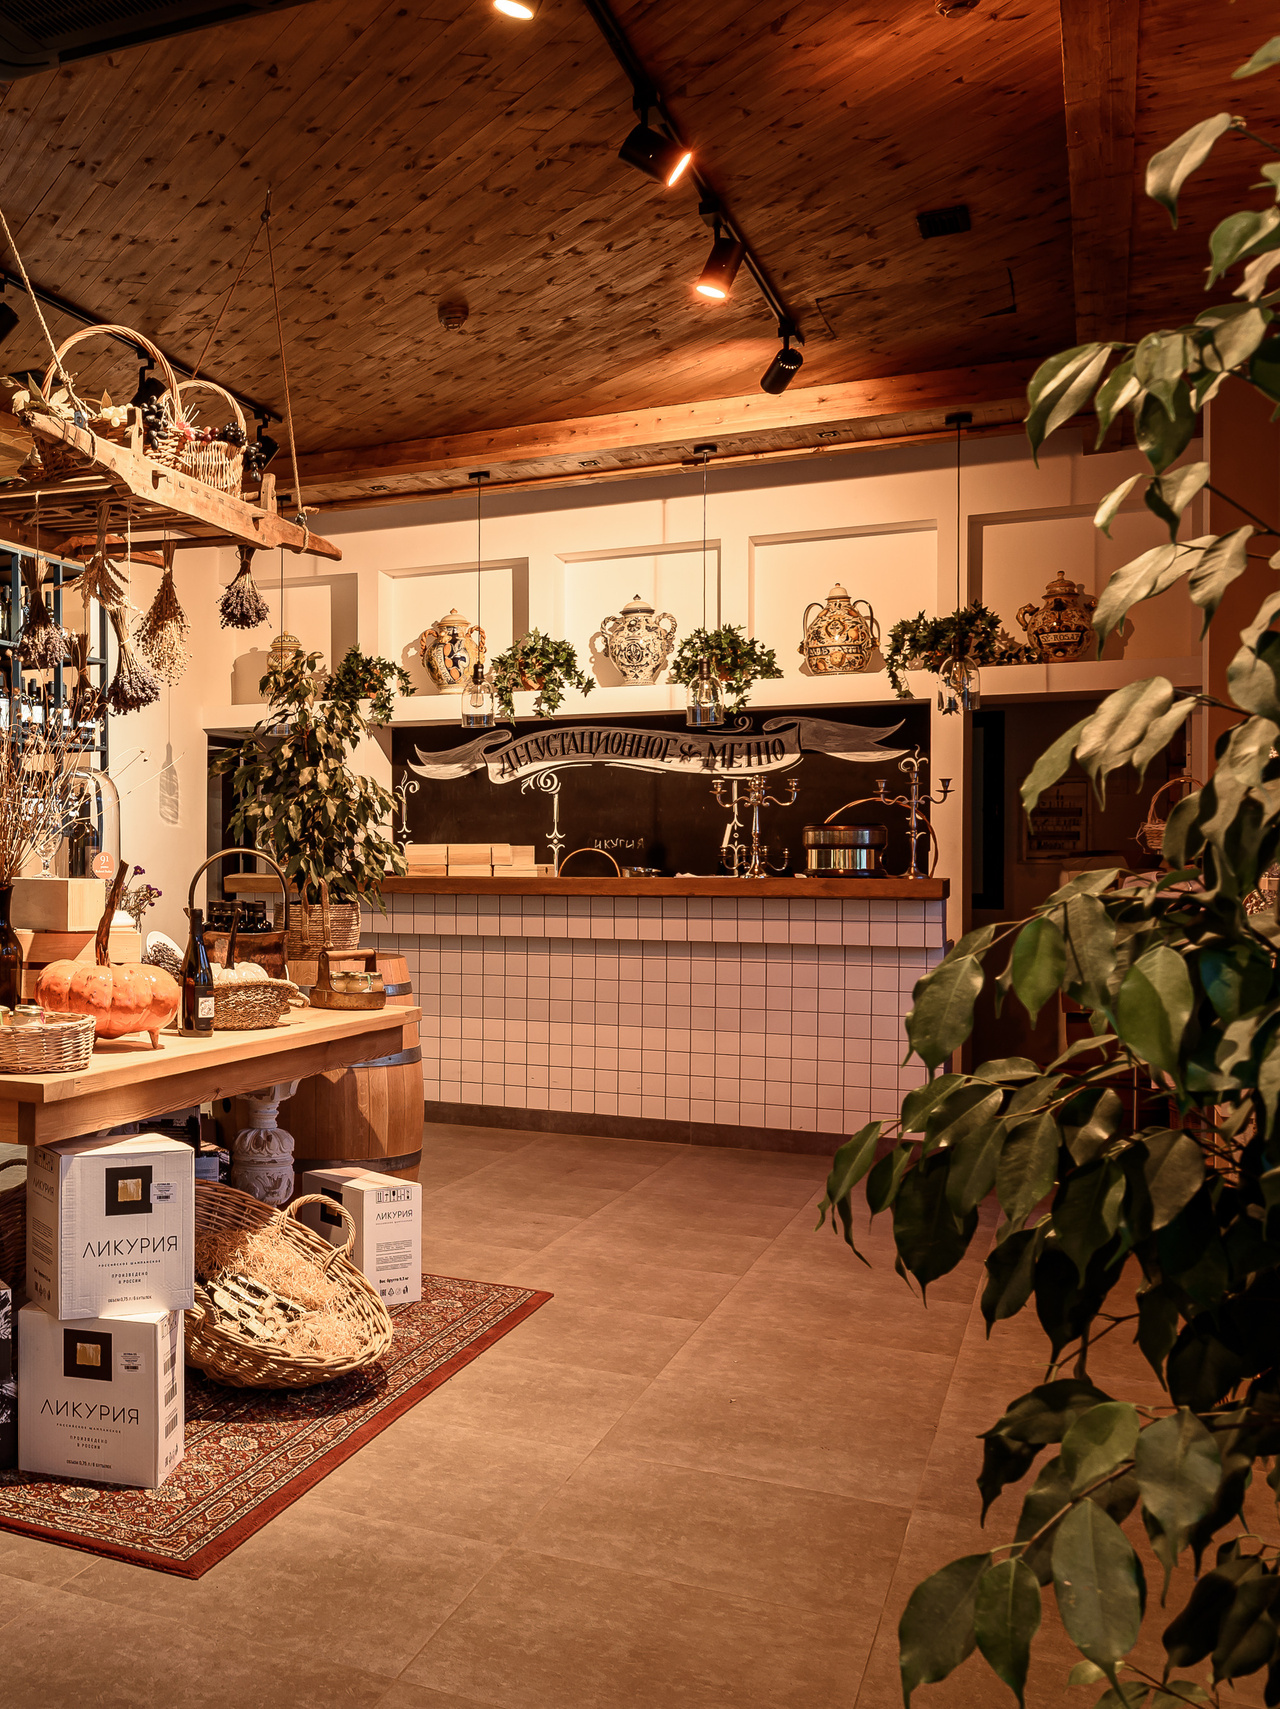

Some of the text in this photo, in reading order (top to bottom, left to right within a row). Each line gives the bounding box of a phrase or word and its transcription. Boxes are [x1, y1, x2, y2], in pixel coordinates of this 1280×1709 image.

[497, 731, 786, 778] ДЕГУСТАЦИОННОЕ МЕНЮ
[100, 855, 110, 866] 91
[375, 1209, 413, 1221] ЛИКУРИЯ
[82, 1235, 178, 1258] ЛИКУРИЯ
[111, 1271, 149, 1279] ПРОИЗВЕДЕНО
[40, 1399, 139, 1425] ЛИКУРИЯ
[70, 1435, 108, 1444] ПРОИЗВЕДЕНО
